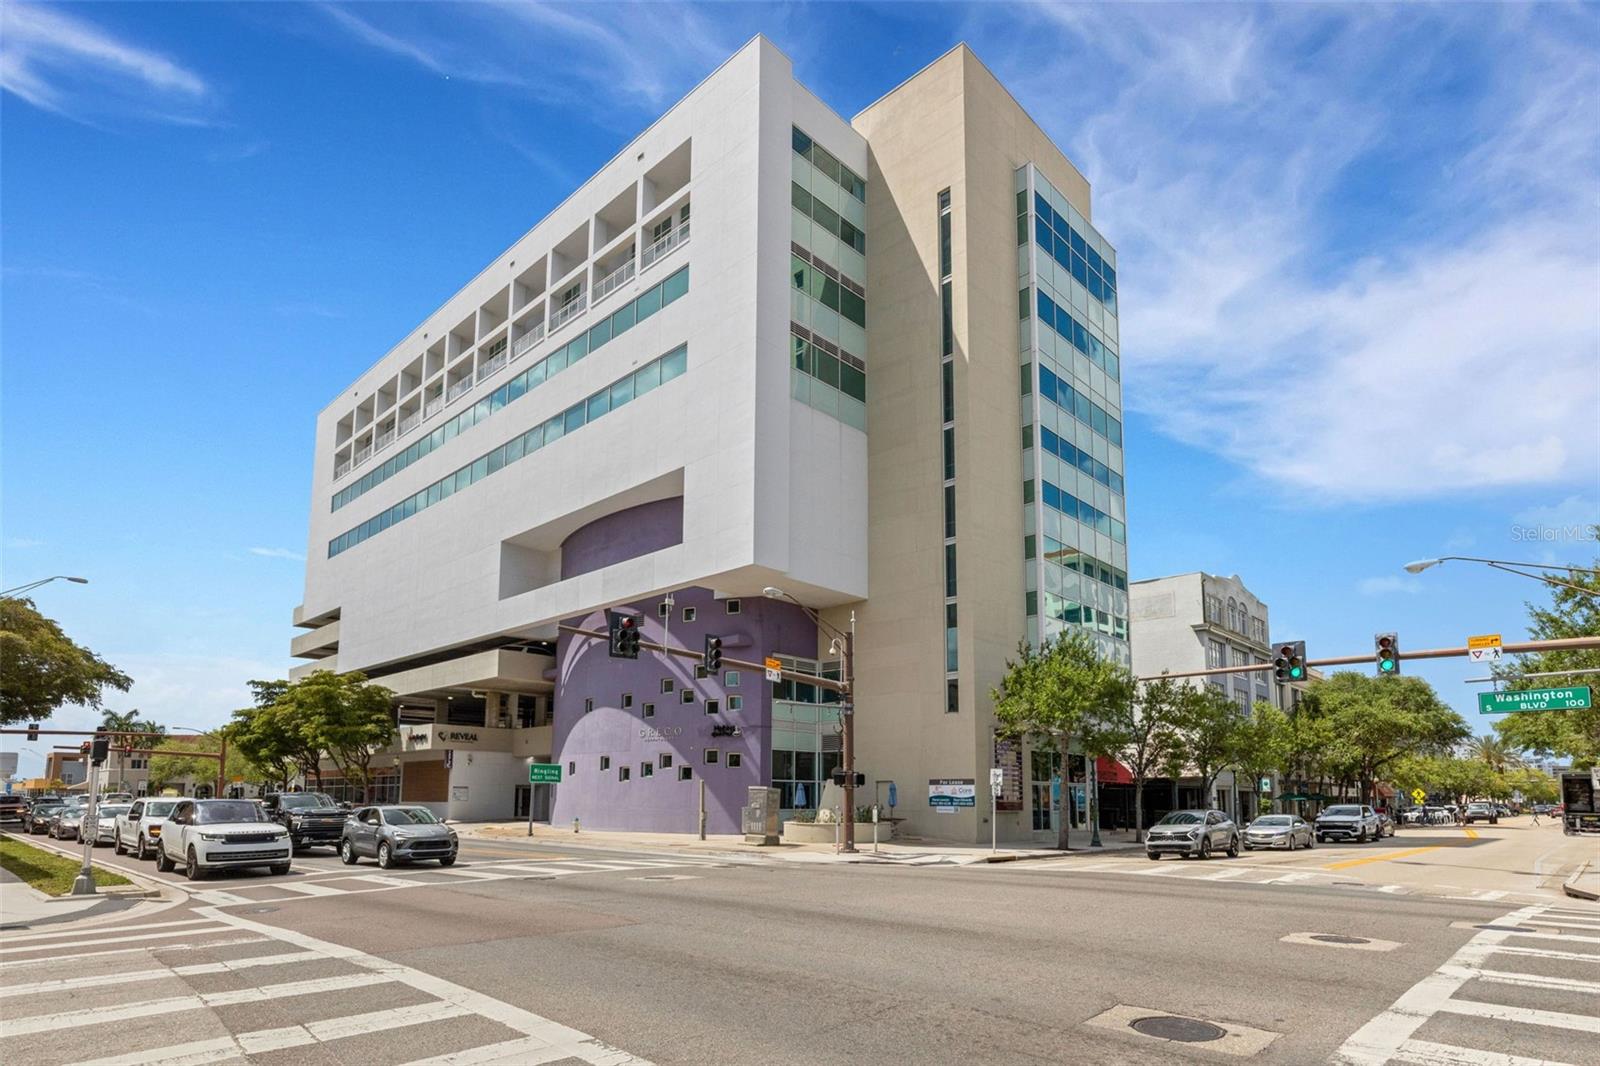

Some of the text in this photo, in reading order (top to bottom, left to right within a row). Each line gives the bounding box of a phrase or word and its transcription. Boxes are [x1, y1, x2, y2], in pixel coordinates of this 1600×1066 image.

[1495, 691, 1573, 702] Washington
[1485, 699, 1585, 712] S BLVD 100
[450, 732, 478, 742] REVEAL
